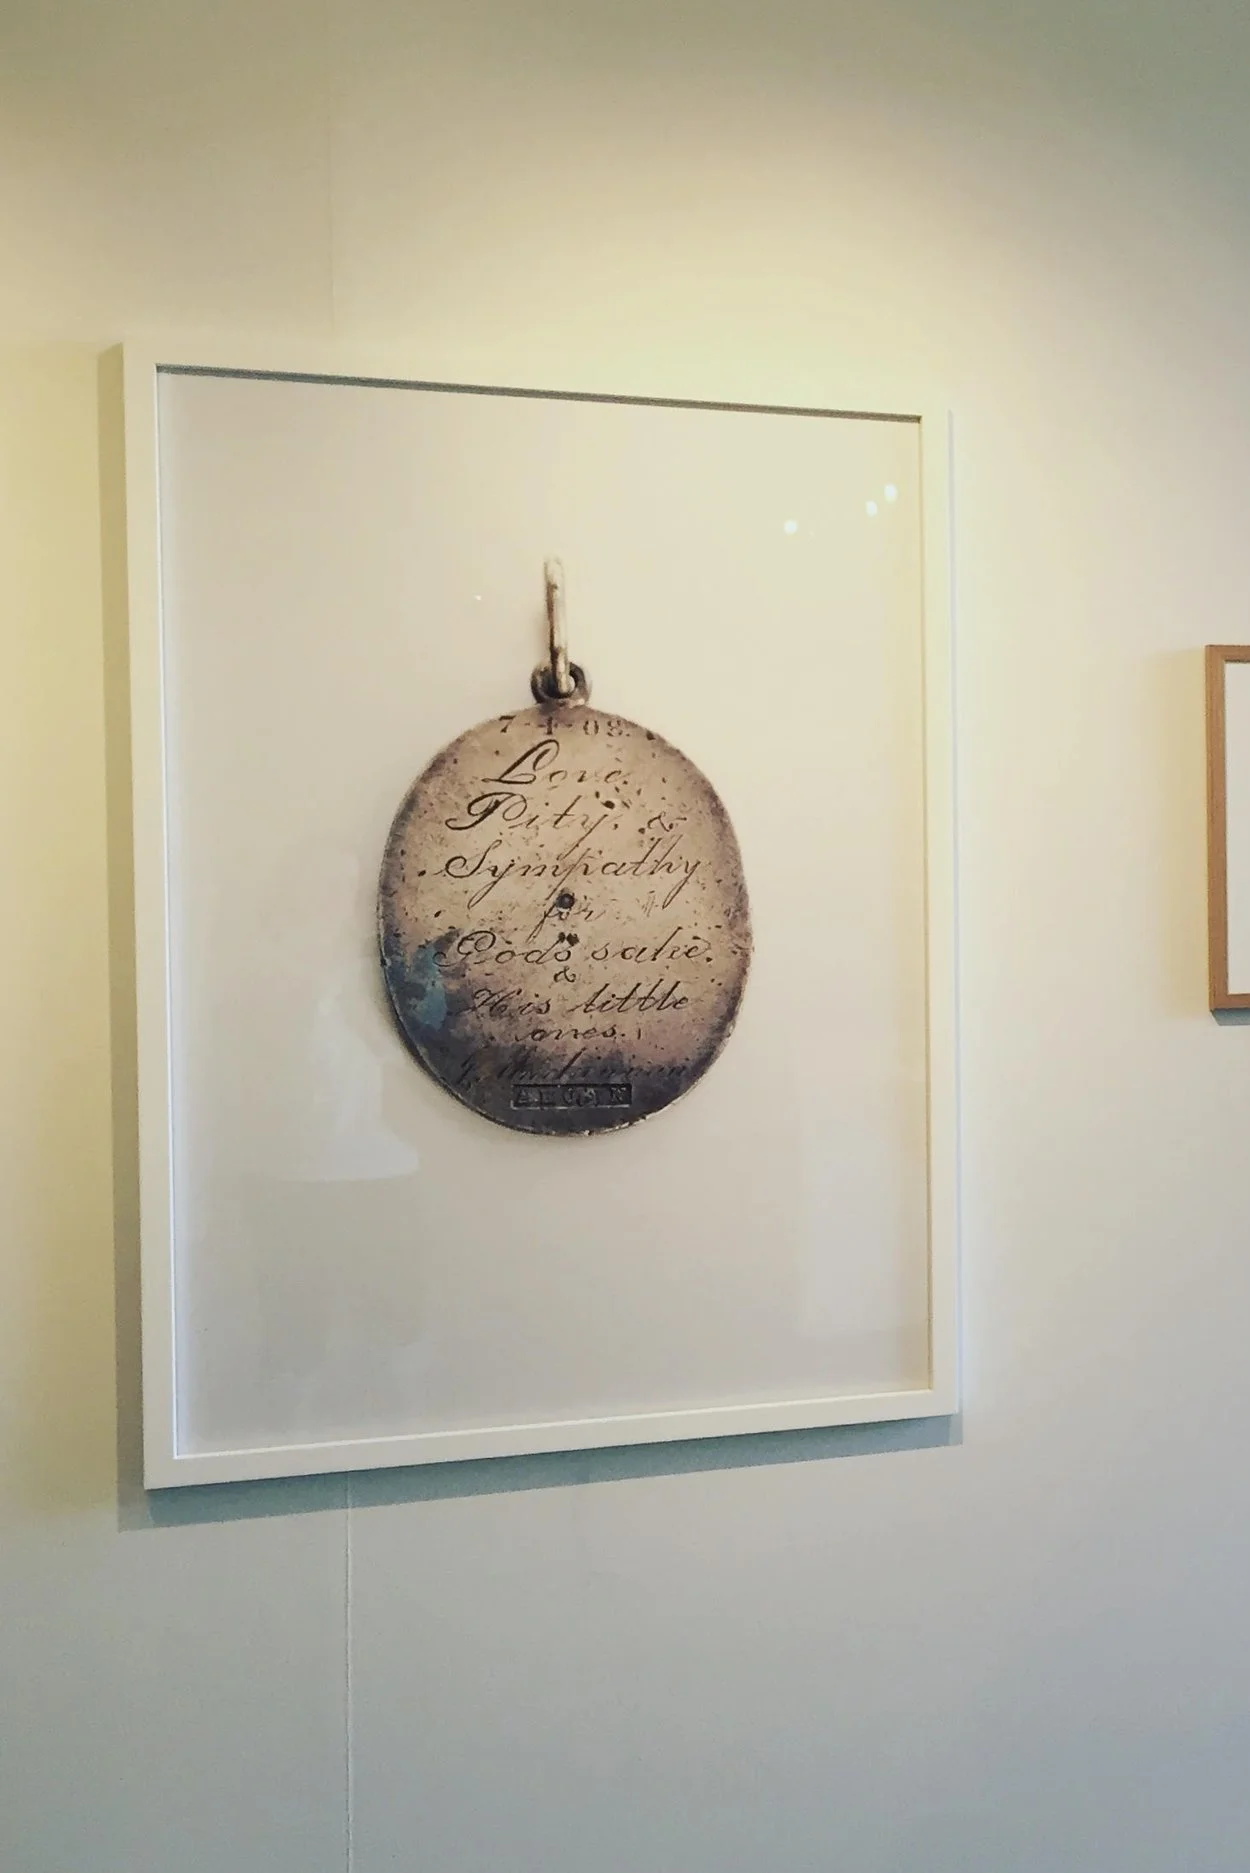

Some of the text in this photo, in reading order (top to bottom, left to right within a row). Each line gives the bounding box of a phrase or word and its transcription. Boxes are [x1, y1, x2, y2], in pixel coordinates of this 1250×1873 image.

[444, 833, 702, 910] Sympathy
[552, 965, 577, 984] &
[567, 979, 690, 1015] little
